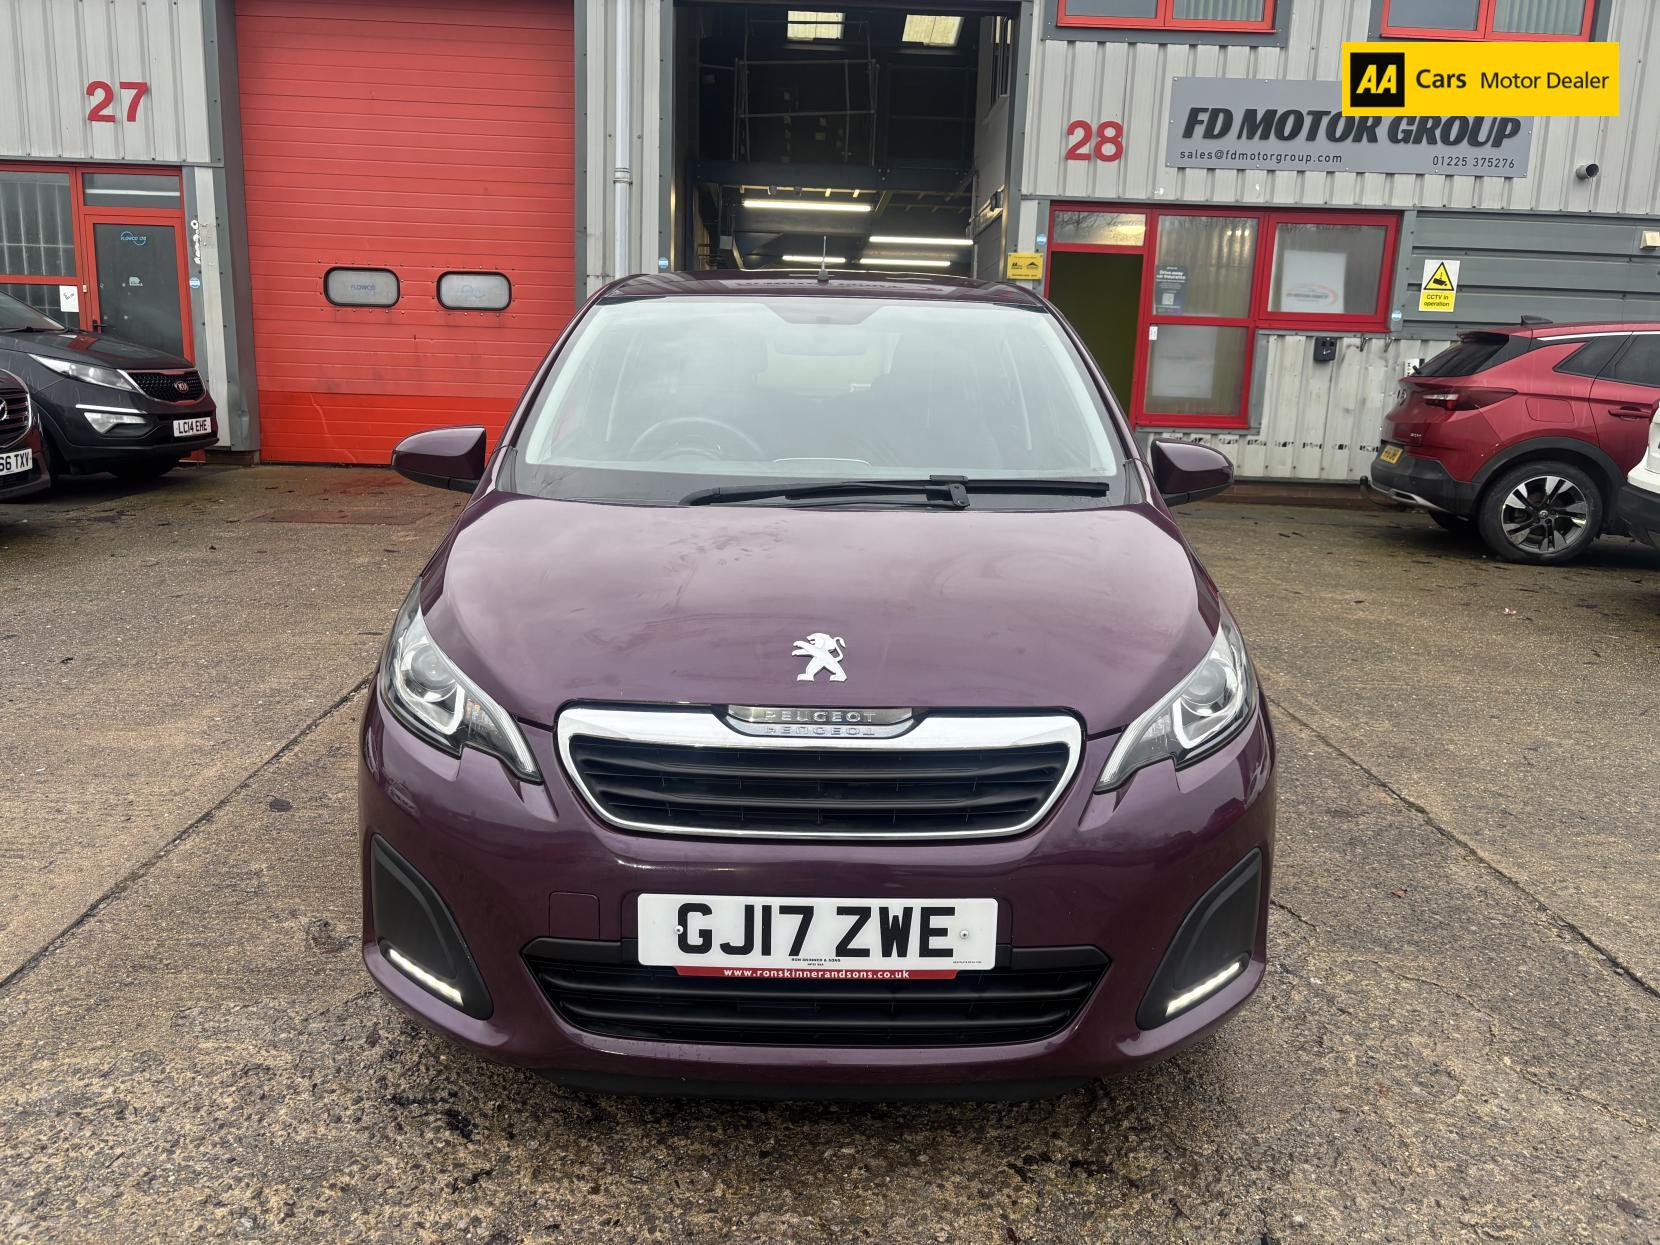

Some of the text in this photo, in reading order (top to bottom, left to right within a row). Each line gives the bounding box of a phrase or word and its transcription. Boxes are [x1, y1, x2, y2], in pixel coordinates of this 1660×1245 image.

[86, 81, 148, 122] 27
[1182, 107, 1521, 148] FD MOTOR GROUP
[1065, 120, 1123, 162] 28
[1180, 149, 1342, 164] sales@fdmotorgroup.com
[1432, 156, 1515, 169] 01225 375276
[195, 419, 207, 432] EHE
[14, 451, 30, 469] TXV
[764, 711, 876, 723] PEUGEOT
[677, 903, 956, 958] GJ17 ZWE
[724, 968, 910, 980] www.ronskinnerandsons.co.uk
